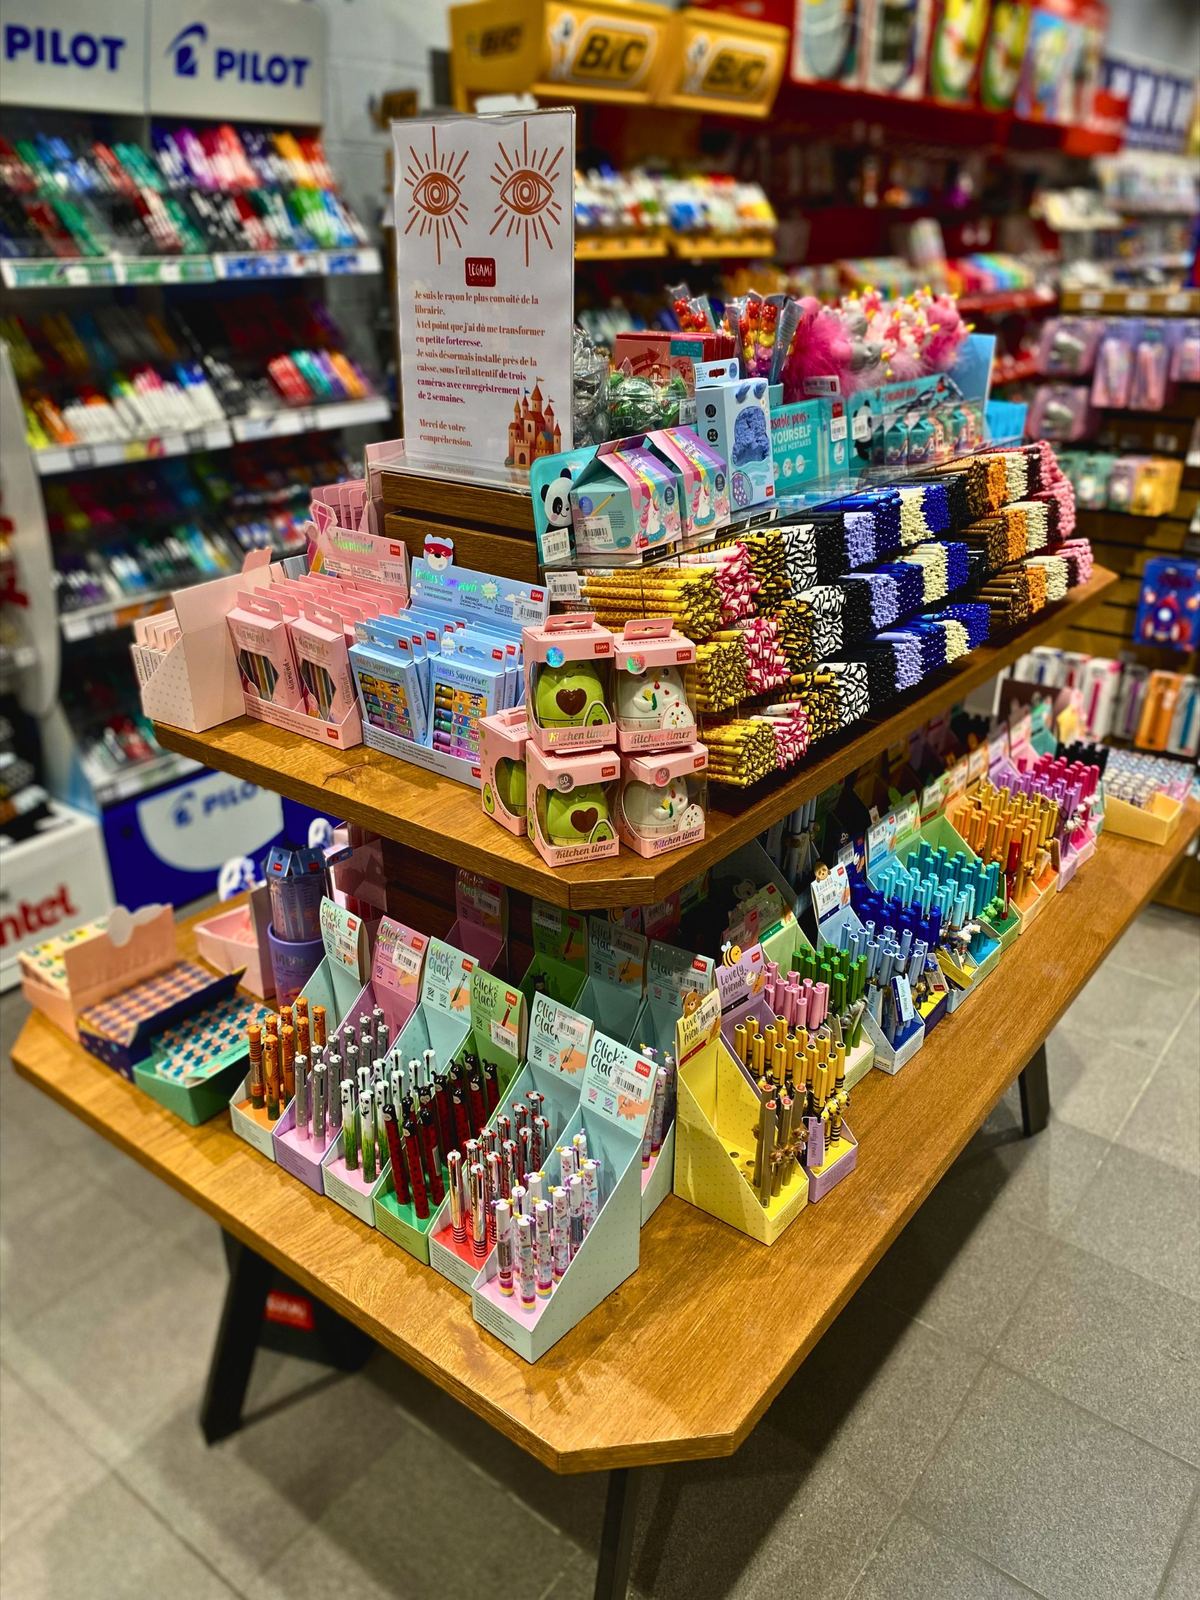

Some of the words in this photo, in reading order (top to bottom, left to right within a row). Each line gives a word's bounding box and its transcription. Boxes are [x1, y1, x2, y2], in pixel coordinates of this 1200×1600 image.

[5, 23, 126, 71] PILOT
[214, 47, 311, 88] PILOT
[414, 290, 422, 299] Je
[423, 291, 437, 300] suis
[437, 291, 444, 300] le
[444, 293, 465, 304] rayon
[465, 292, 473, 302] le
[473, 293, 489, 304] plus
[489, 294, 520, 304] convoité
[521, 294, 530, 305] de
[531, 295, 539, 305] la
[414, 304, 446, 316] librairie.
[421, 320, 431, 329] tel
[431, 321, 450, 332] point
[450, 323, 463, 333] que
[476, 323, 486, 333] dû
[486, 325, 498, 334] me
[499, 325, 546, 337] transformer
[425, 335, 445, 345] petite
[445, 336, 483, 348] forteresse.
[416, 348, 424, 357] Je
[425, 349, 438, 358] suis
[439, 350, 474, 361] désormais
[475, 352, 502, 363] installé
[502, 356, 519, 367] près
[519, 356, 529, 366] de
[530, 357, 537, 367] la
[416, 363, 439, 373] caisse,
[440, 367, 455, 375] sous
[471, 367, 498, 377] attentif
[499, 370, 508, 379] de
[508, 371, 527, 381] trois
[417, 378, 446, 388] caméras
[446, 381, 462, 389] avec
[462, 383, 520, 396] enregristrement
[417, 390, 427, 399] de
[427, 392, 431, 400] 2
[432, 393, 466, 404] semaines.
[419, 418, 439, 430] Merci
[439, 420, 448, 430] de
[448, 422, 466, 432] votre
[419, 434, 473, 447] compréhension.
[772, 424, 812, 445] YOURSELF
[666, 730, 692, 741] timer
[201, 780, 262, 817] PILO
[682, 828, 702, 841] timer
[555, 844, 591, 859] Kitchen
[591, 842, 616, 854] timer
[428, 956, 452, 983] Clack
[720, 964, 744, 987] Lovely
[473, 973, 495, 996] Click
[722, 976, 746, 999] friends
[682, 1013, 698, 1033] Love
[594, 1038, 620, 1063] Click
[591, 1053, 613, 1078] Clac
